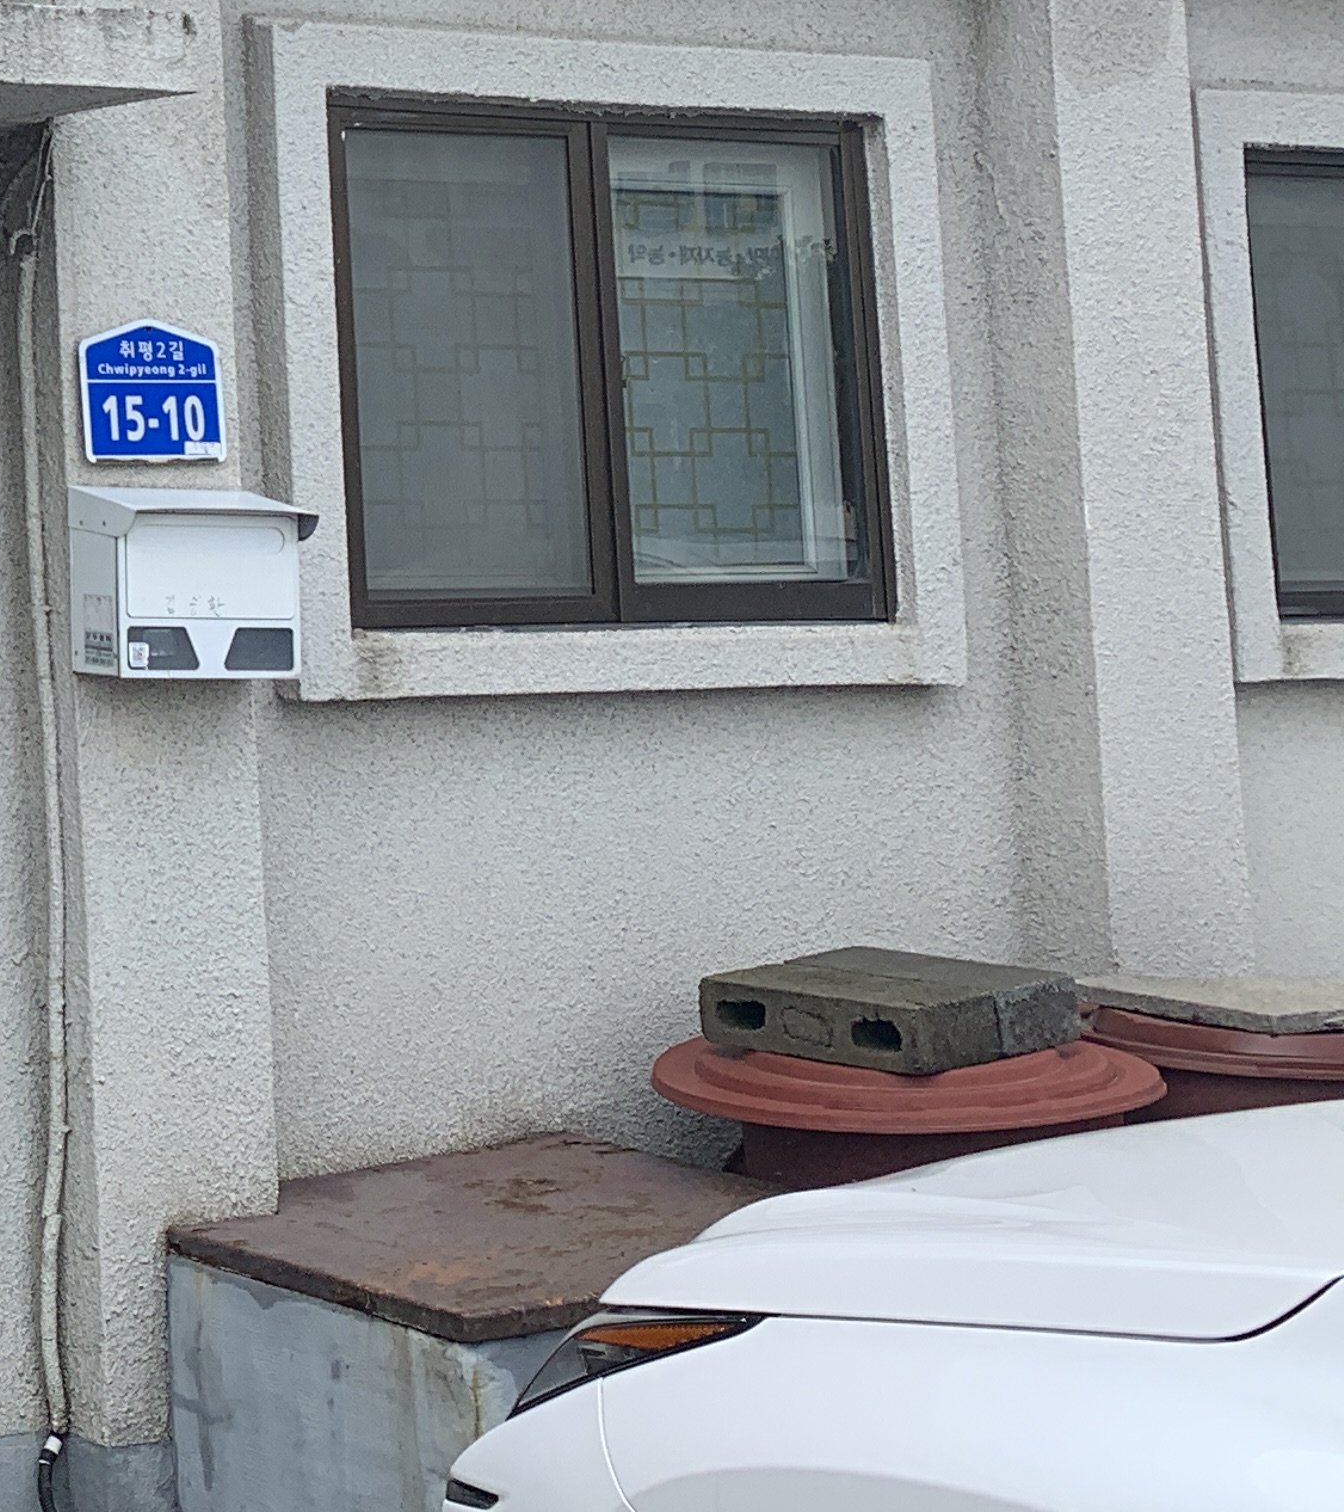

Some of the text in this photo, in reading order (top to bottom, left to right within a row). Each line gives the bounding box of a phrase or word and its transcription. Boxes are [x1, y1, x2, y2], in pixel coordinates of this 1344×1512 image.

[118, 339, 185, 363] 취평2길
[97, 362, 208, 378] Chwipyeong 2-gil
[102, 394, 205, 442] 15-10
